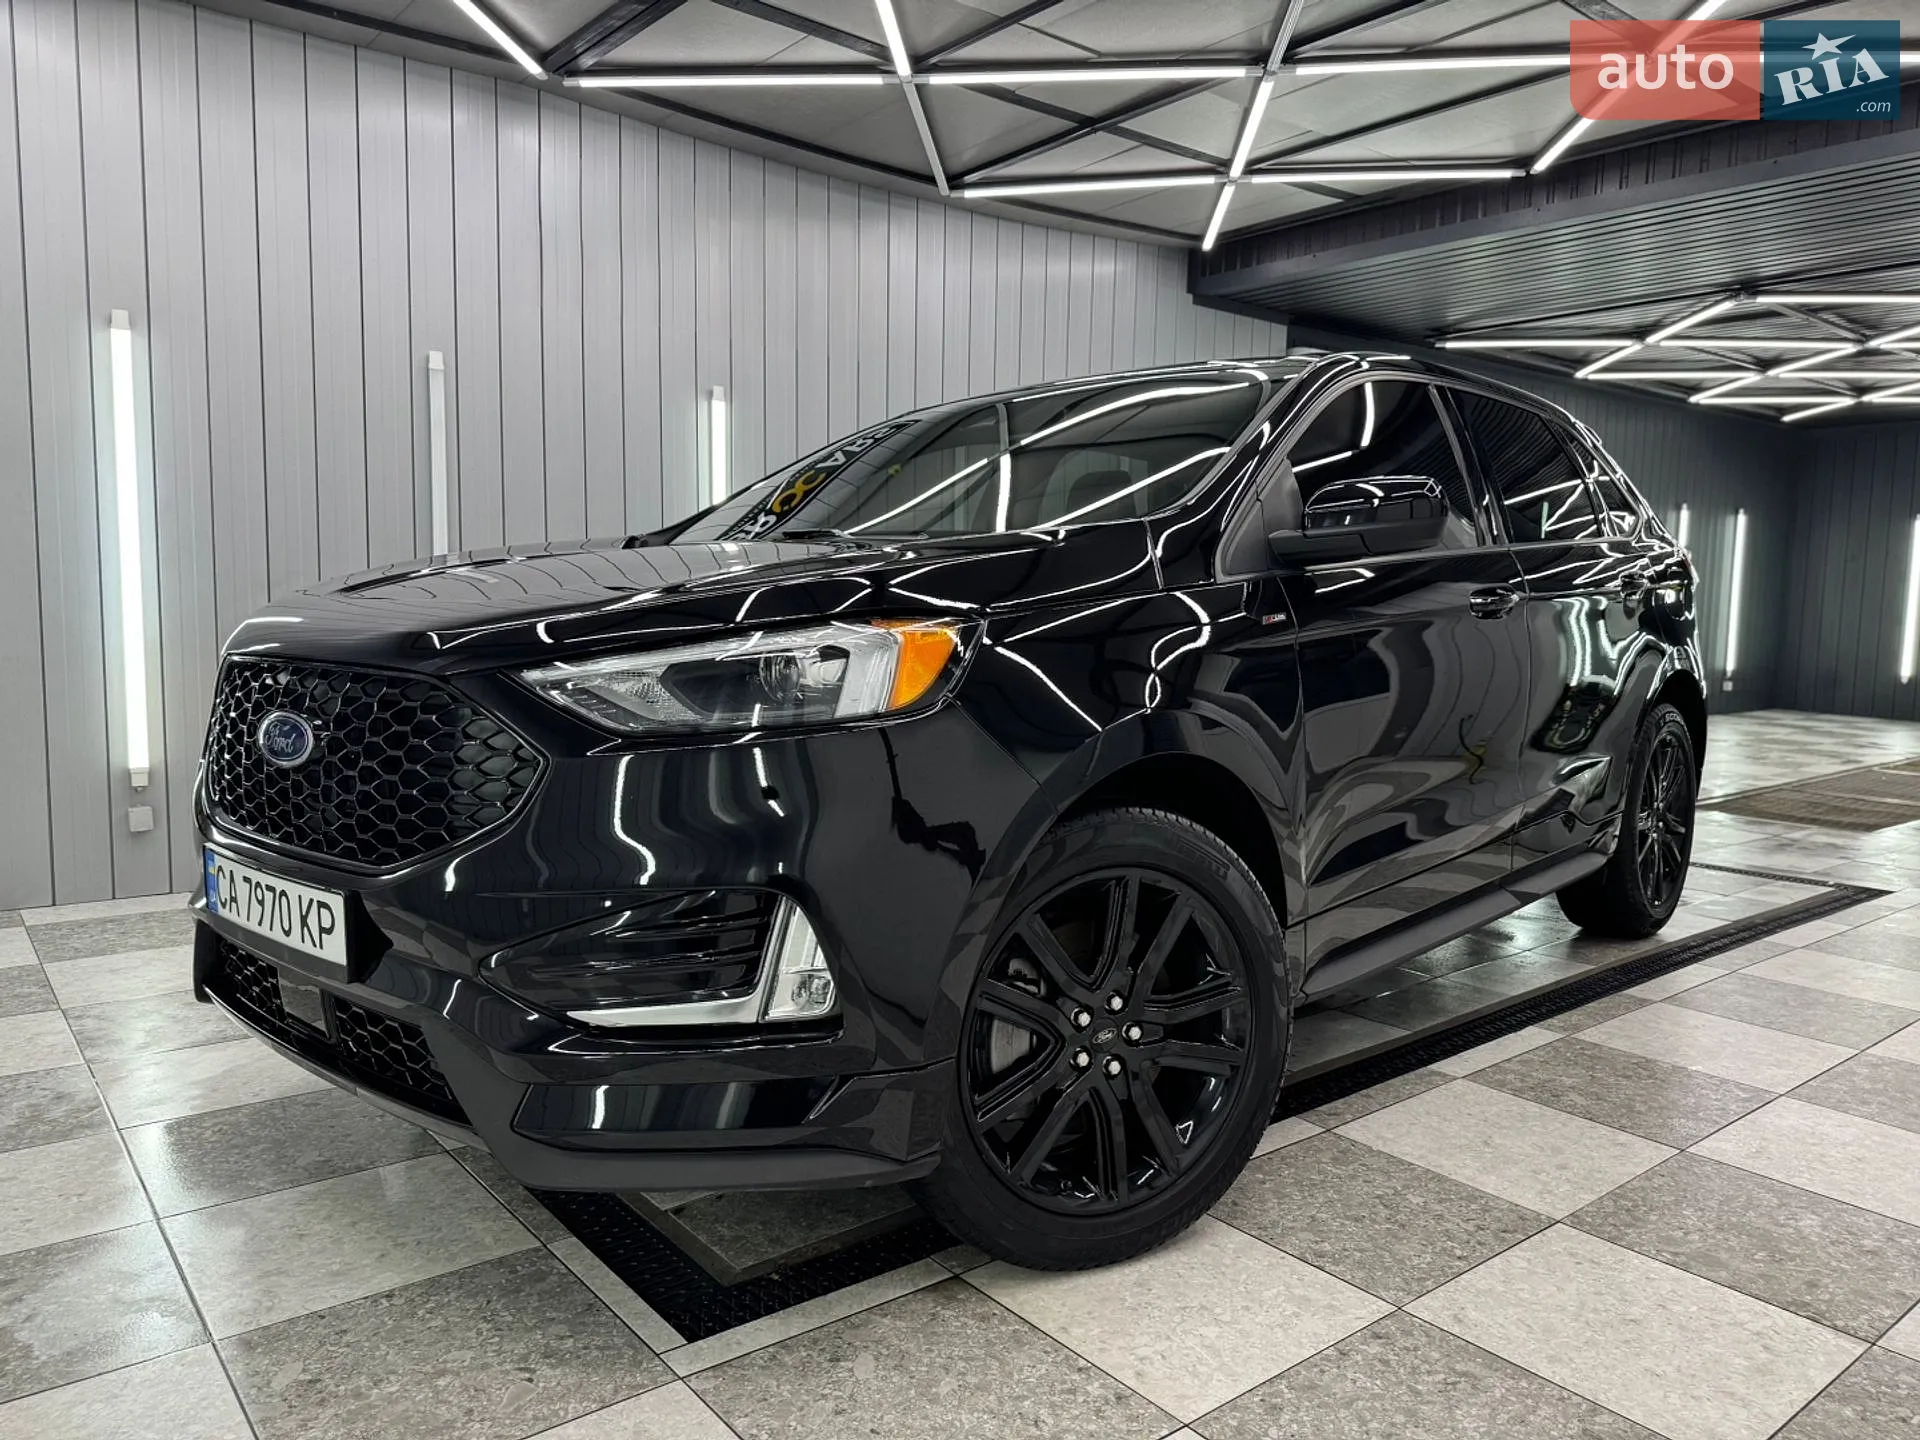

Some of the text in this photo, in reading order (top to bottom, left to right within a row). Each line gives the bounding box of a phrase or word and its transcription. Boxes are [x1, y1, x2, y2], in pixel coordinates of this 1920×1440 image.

[265, 721, 298, 753] Ford
[216, 864, 337, 951] CA 7970 KP
